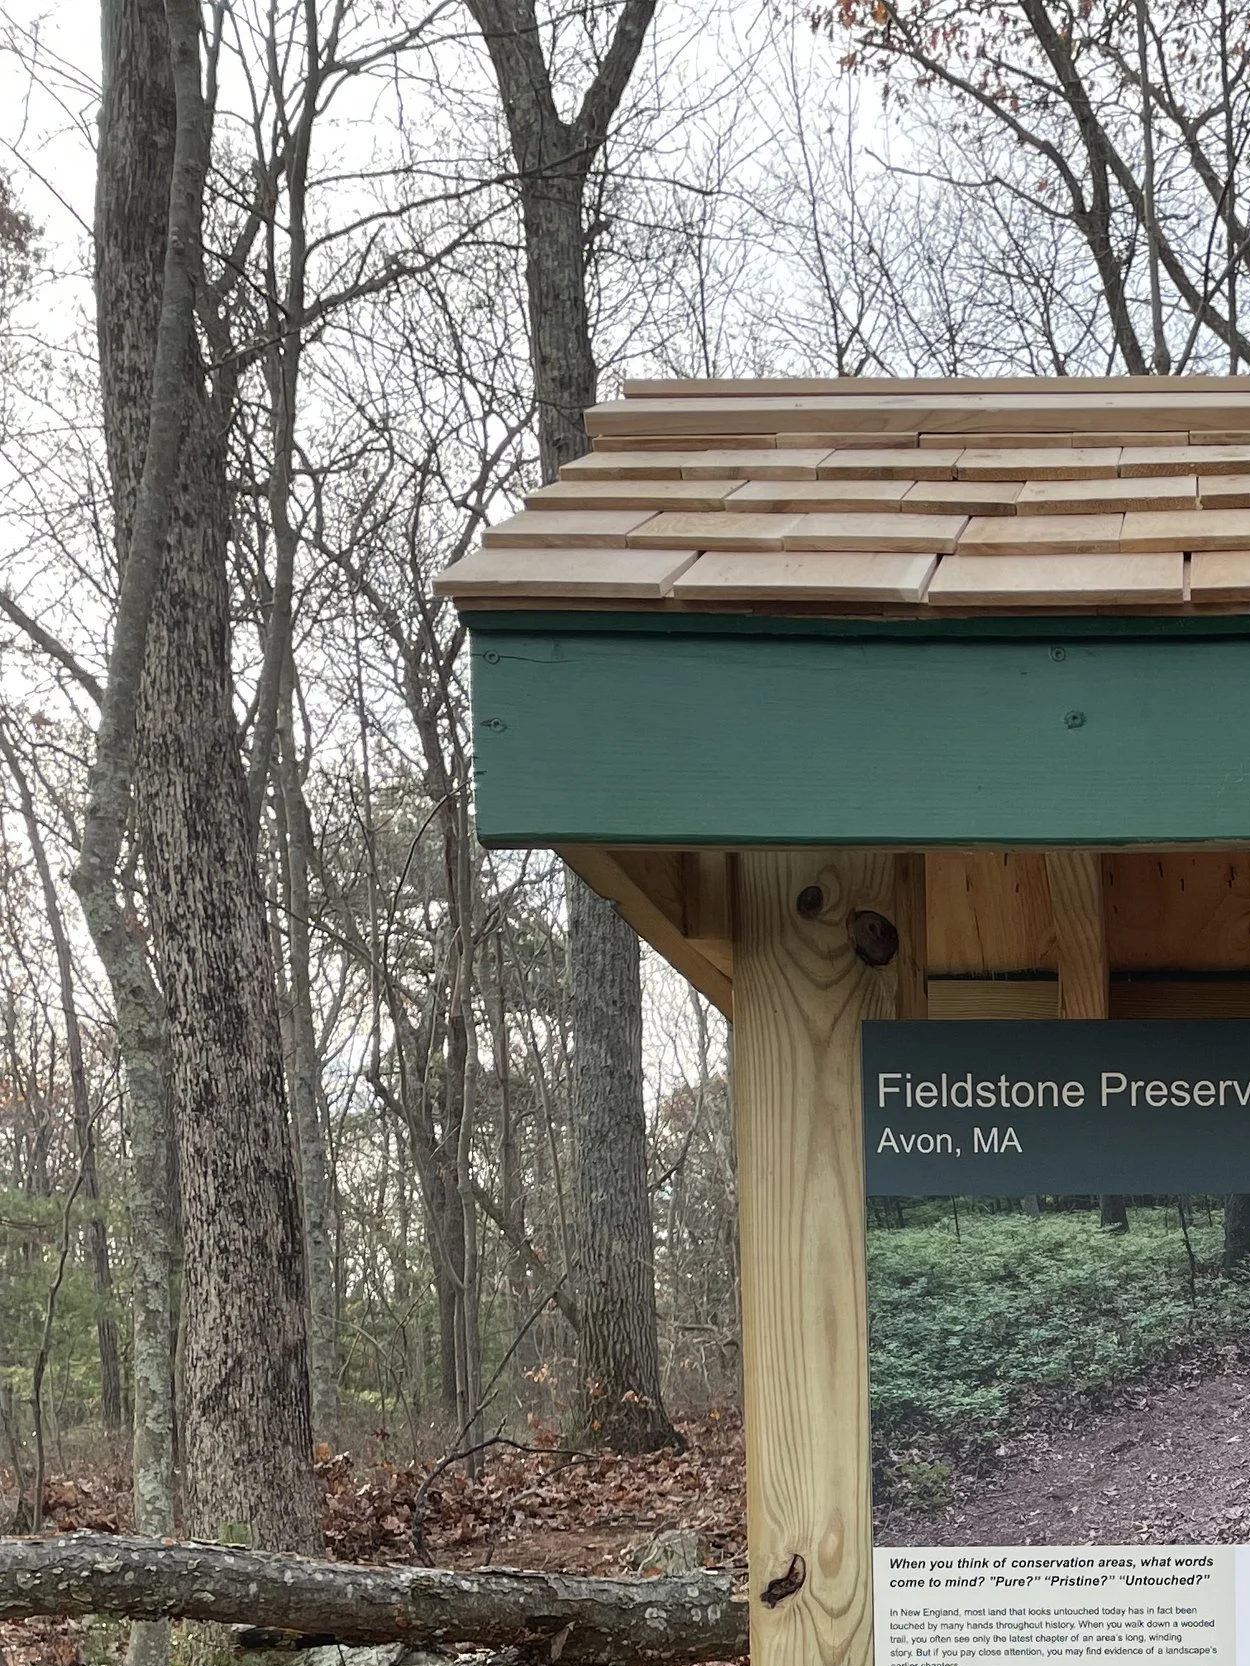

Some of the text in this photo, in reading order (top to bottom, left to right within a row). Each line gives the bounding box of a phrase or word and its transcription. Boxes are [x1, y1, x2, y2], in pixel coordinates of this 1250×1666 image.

[878, 1073, 1084, 1107] Fieldstone
[878, 1127, 1021, 1156] Avon, MA
[890, 1555, 1213, 1571] When you think of conservation areas, what words
[890, 1579, 924, 1587] come
[929, 1577, 941, 1587] to
[945, 1576, 985, 1587] mind?
